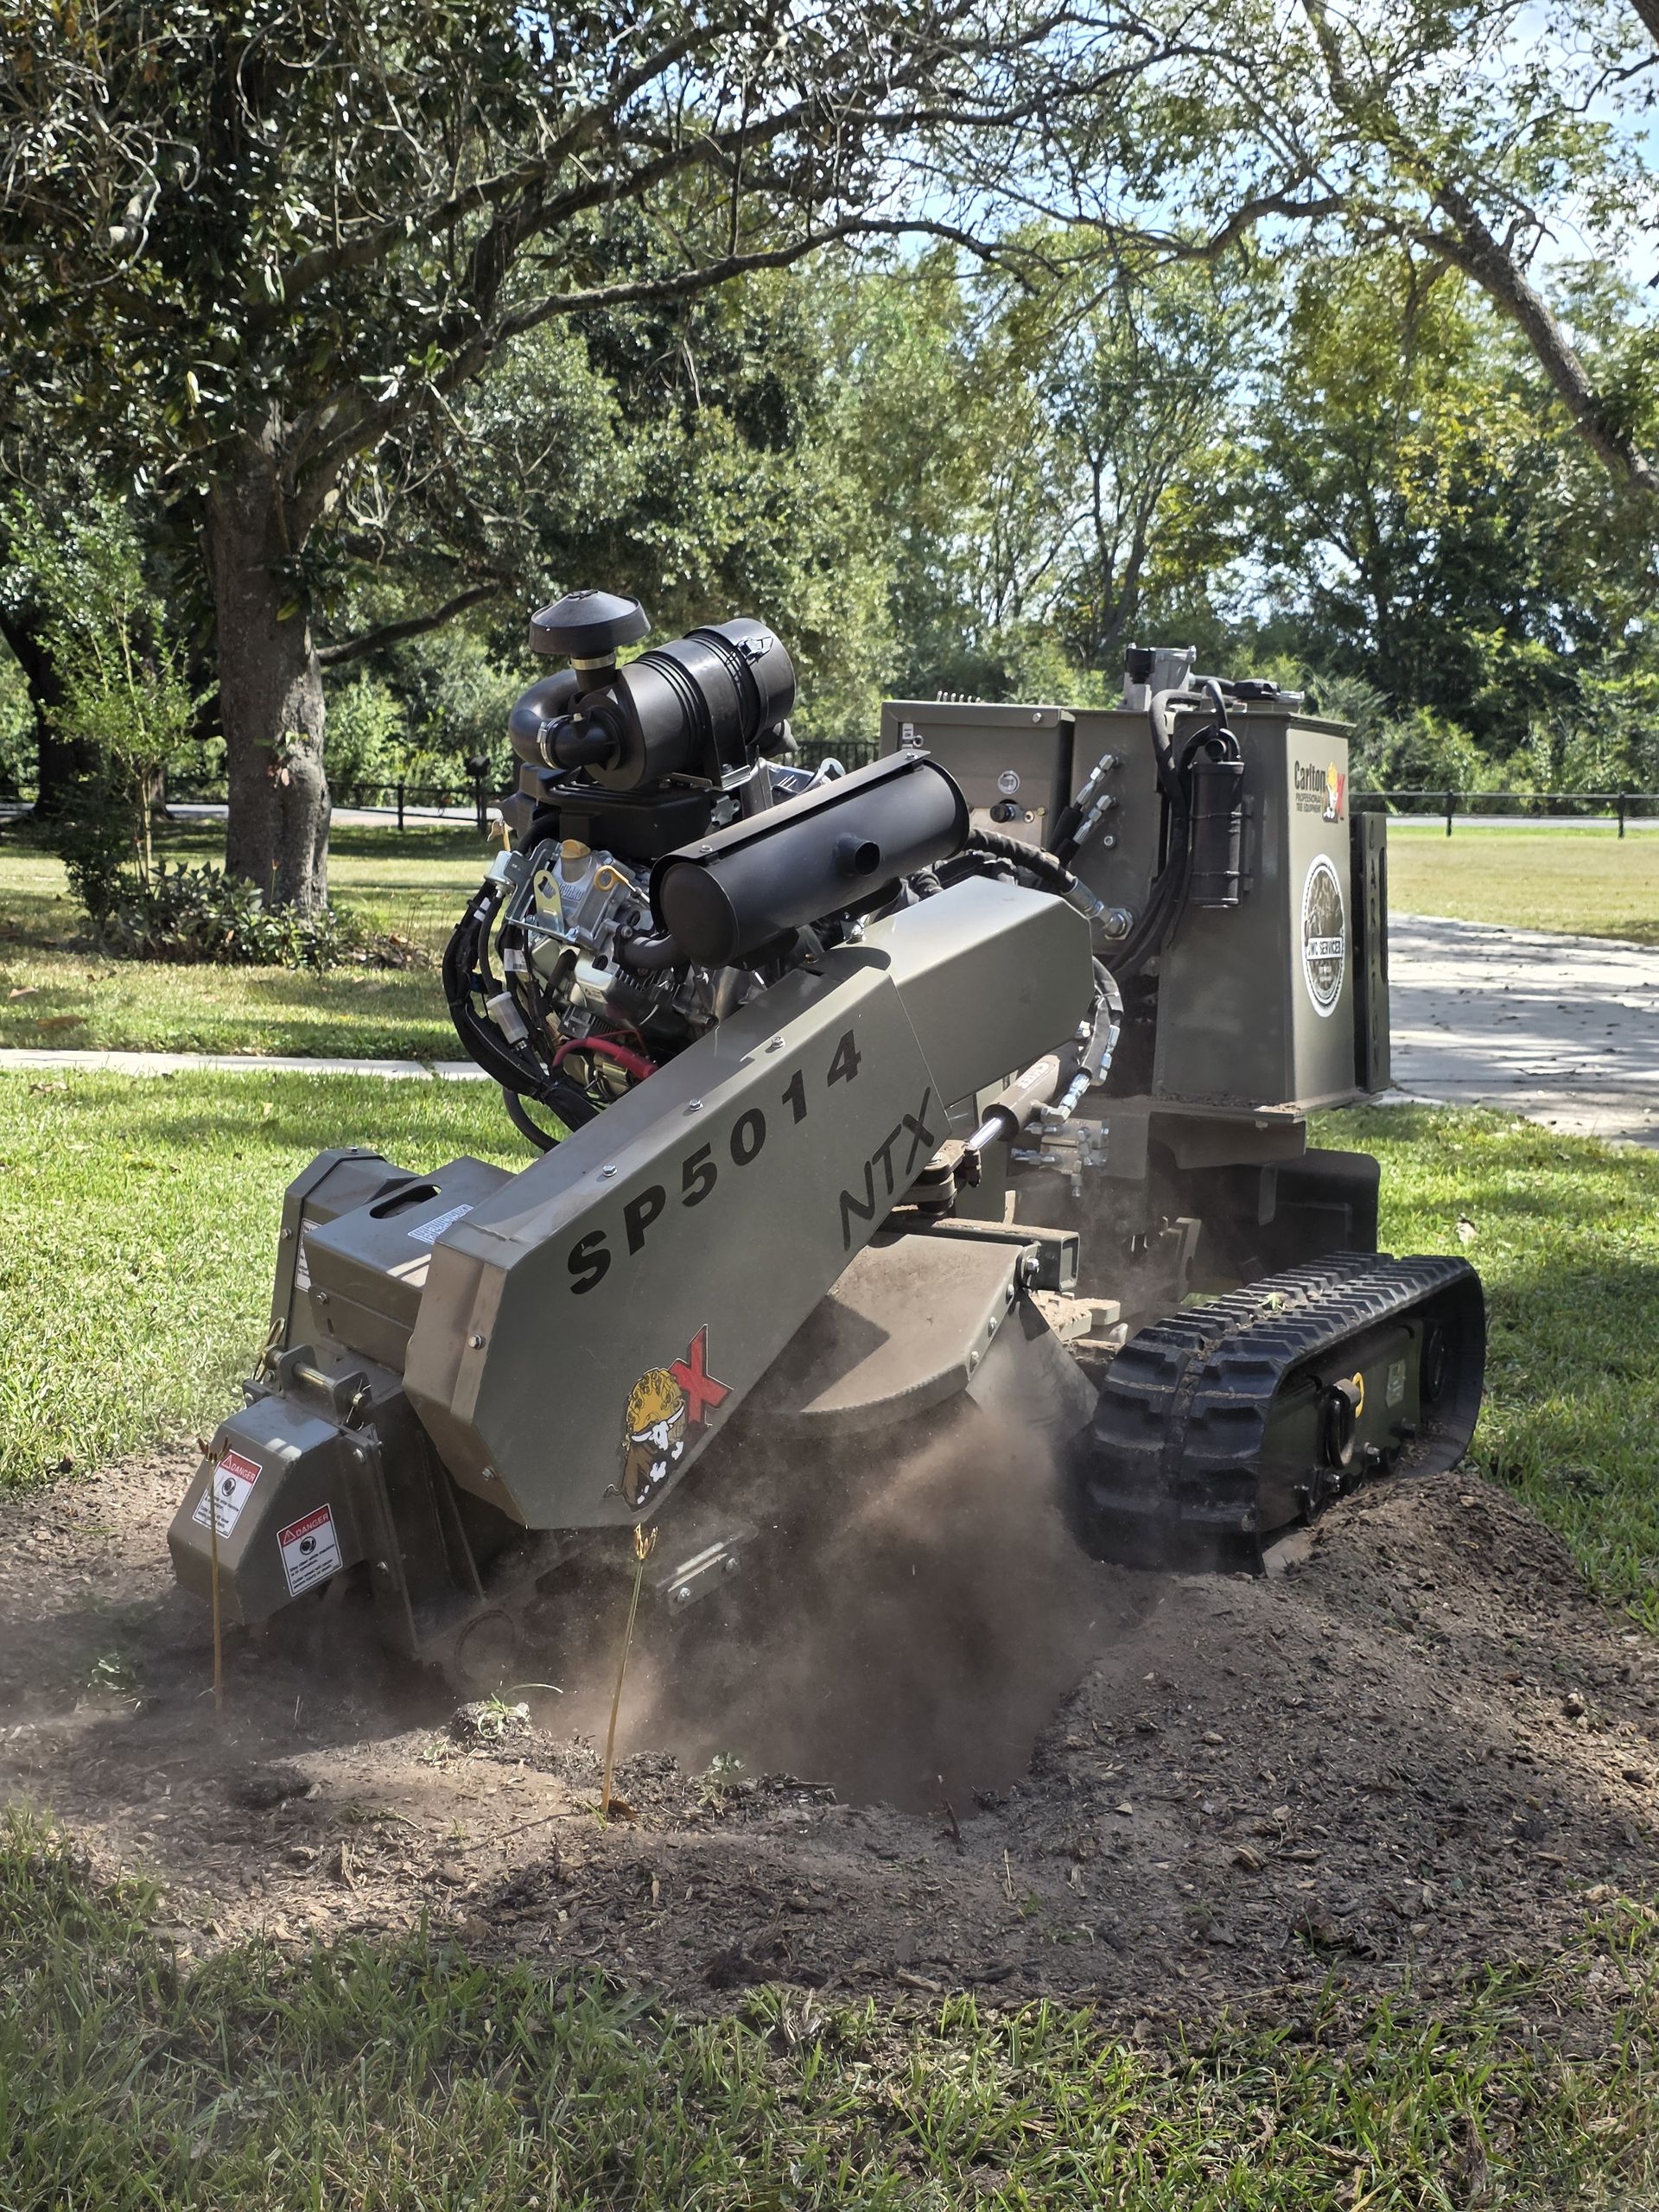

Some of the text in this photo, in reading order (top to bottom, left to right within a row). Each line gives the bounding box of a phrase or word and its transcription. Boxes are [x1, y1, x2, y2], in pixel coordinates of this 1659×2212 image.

[1294, 760, 1325, 792] Carlton
[567, 1029, 862, 1295] SP5014
[839, 1087, 935, 1251] NTX
[230, 1463, 257, 1482] DANGER
[296, 1512, 329, 1537] DANGER
